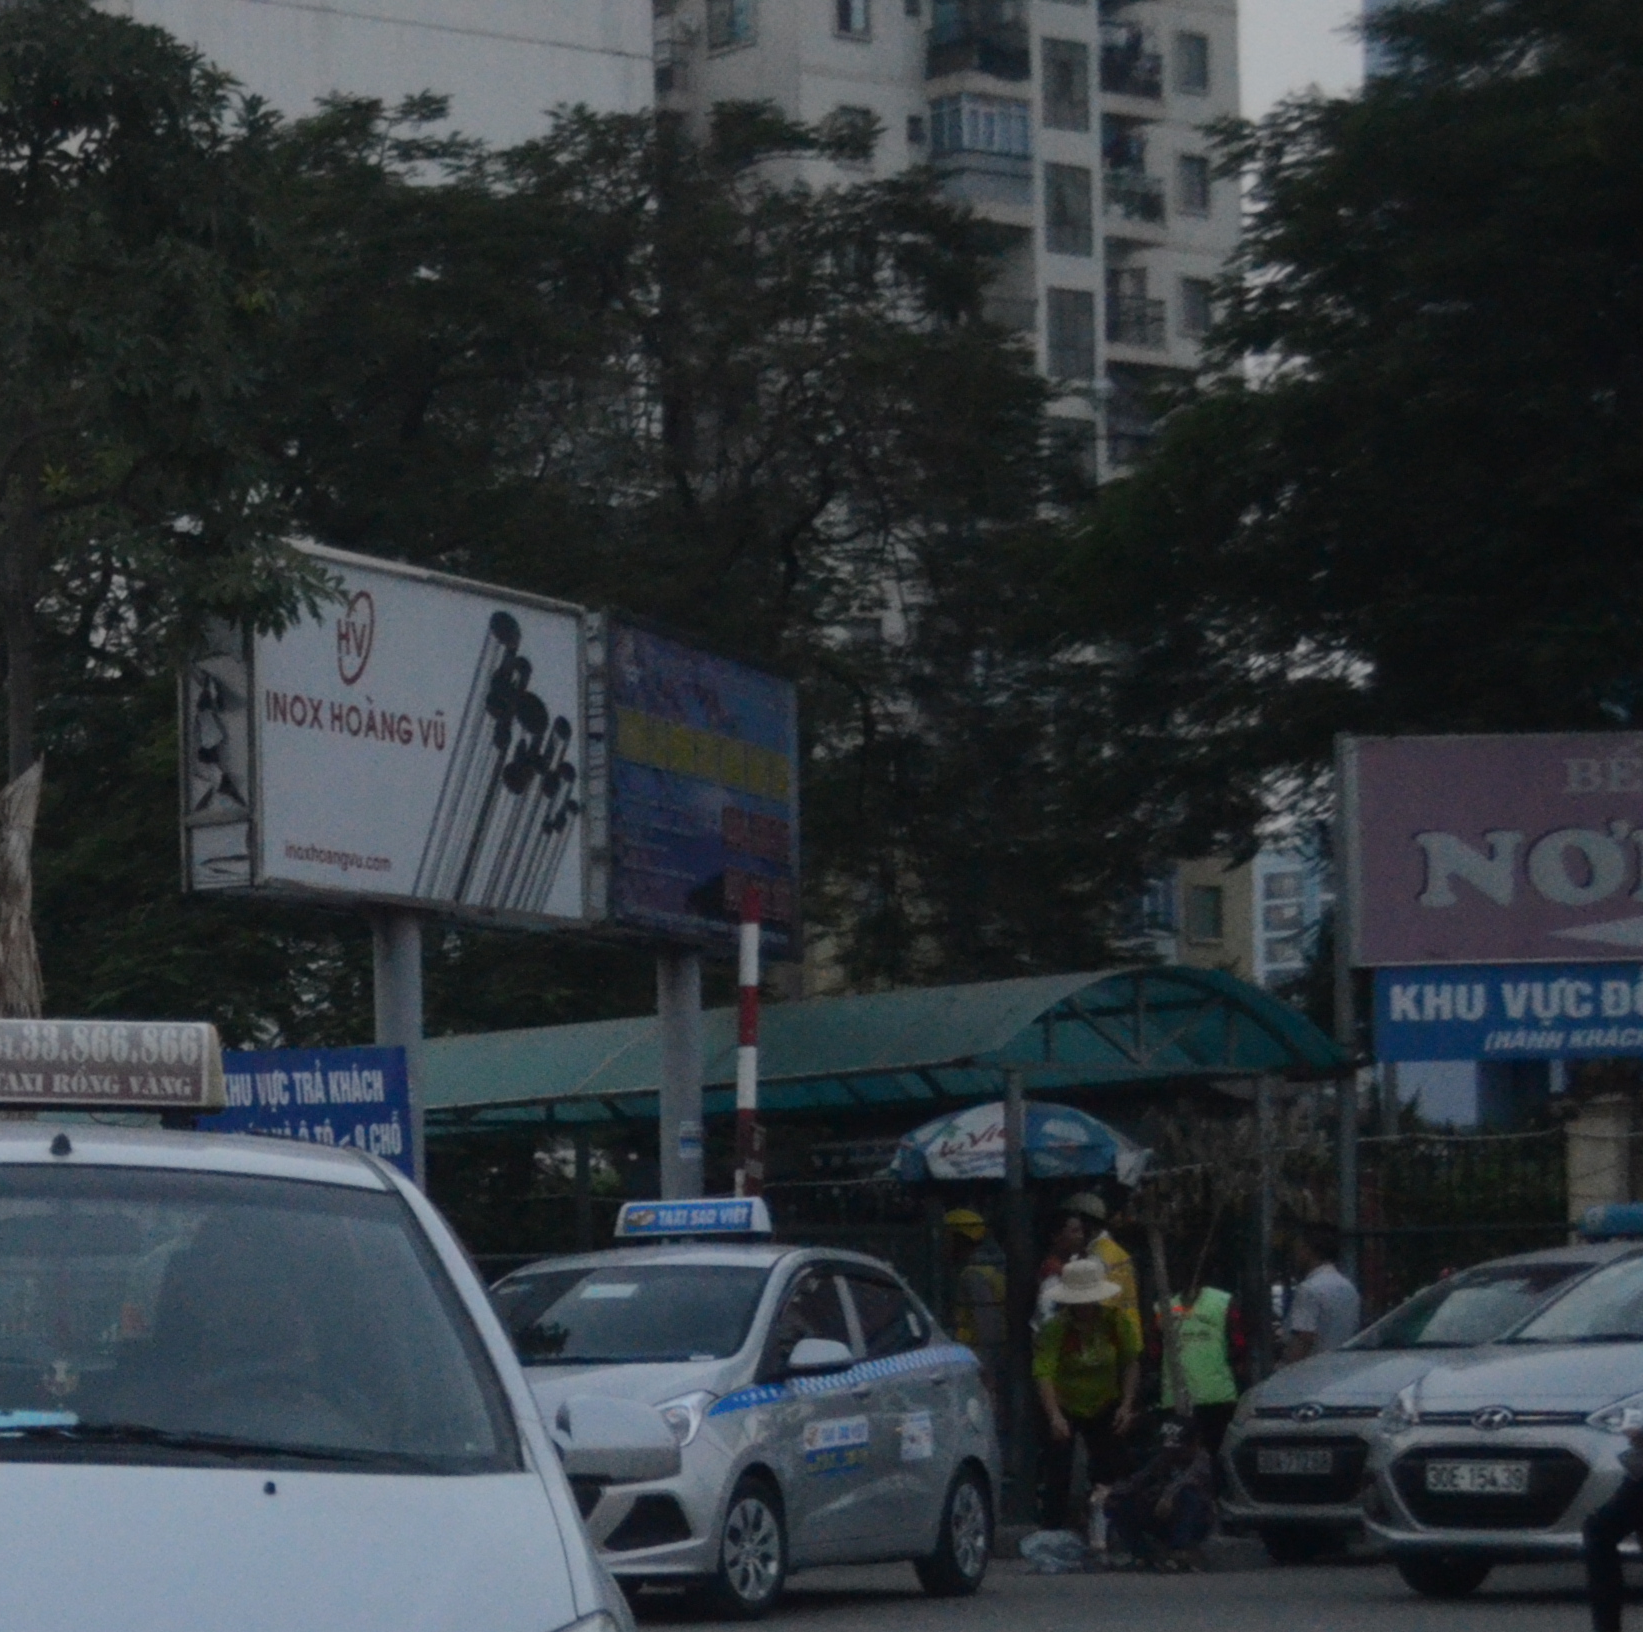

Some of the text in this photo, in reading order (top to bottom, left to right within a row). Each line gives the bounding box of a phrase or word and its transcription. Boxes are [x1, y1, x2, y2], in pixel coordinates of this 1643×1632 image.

[336, 617, 368, 658] HV
[265, 689, 447, 752] INOX HOÀNG VŨ
[284, 841, 393, 873] inoxhoangvu.com
[1412, 817, 1643, 908] NƠ
[1388, 982, 1486, 1022] KHU
[1501, 977, 1594, 1028] VỰC
[1568, 1027, 1643, 1049] KHÁC
[128, 1070, 192, 1097] VÀNG
[254, 1069, 291, 1113] VỰC
[292, 1058, 327, 1106] TRẢ
[328, 1062, 385, 1103] KHÁCH
